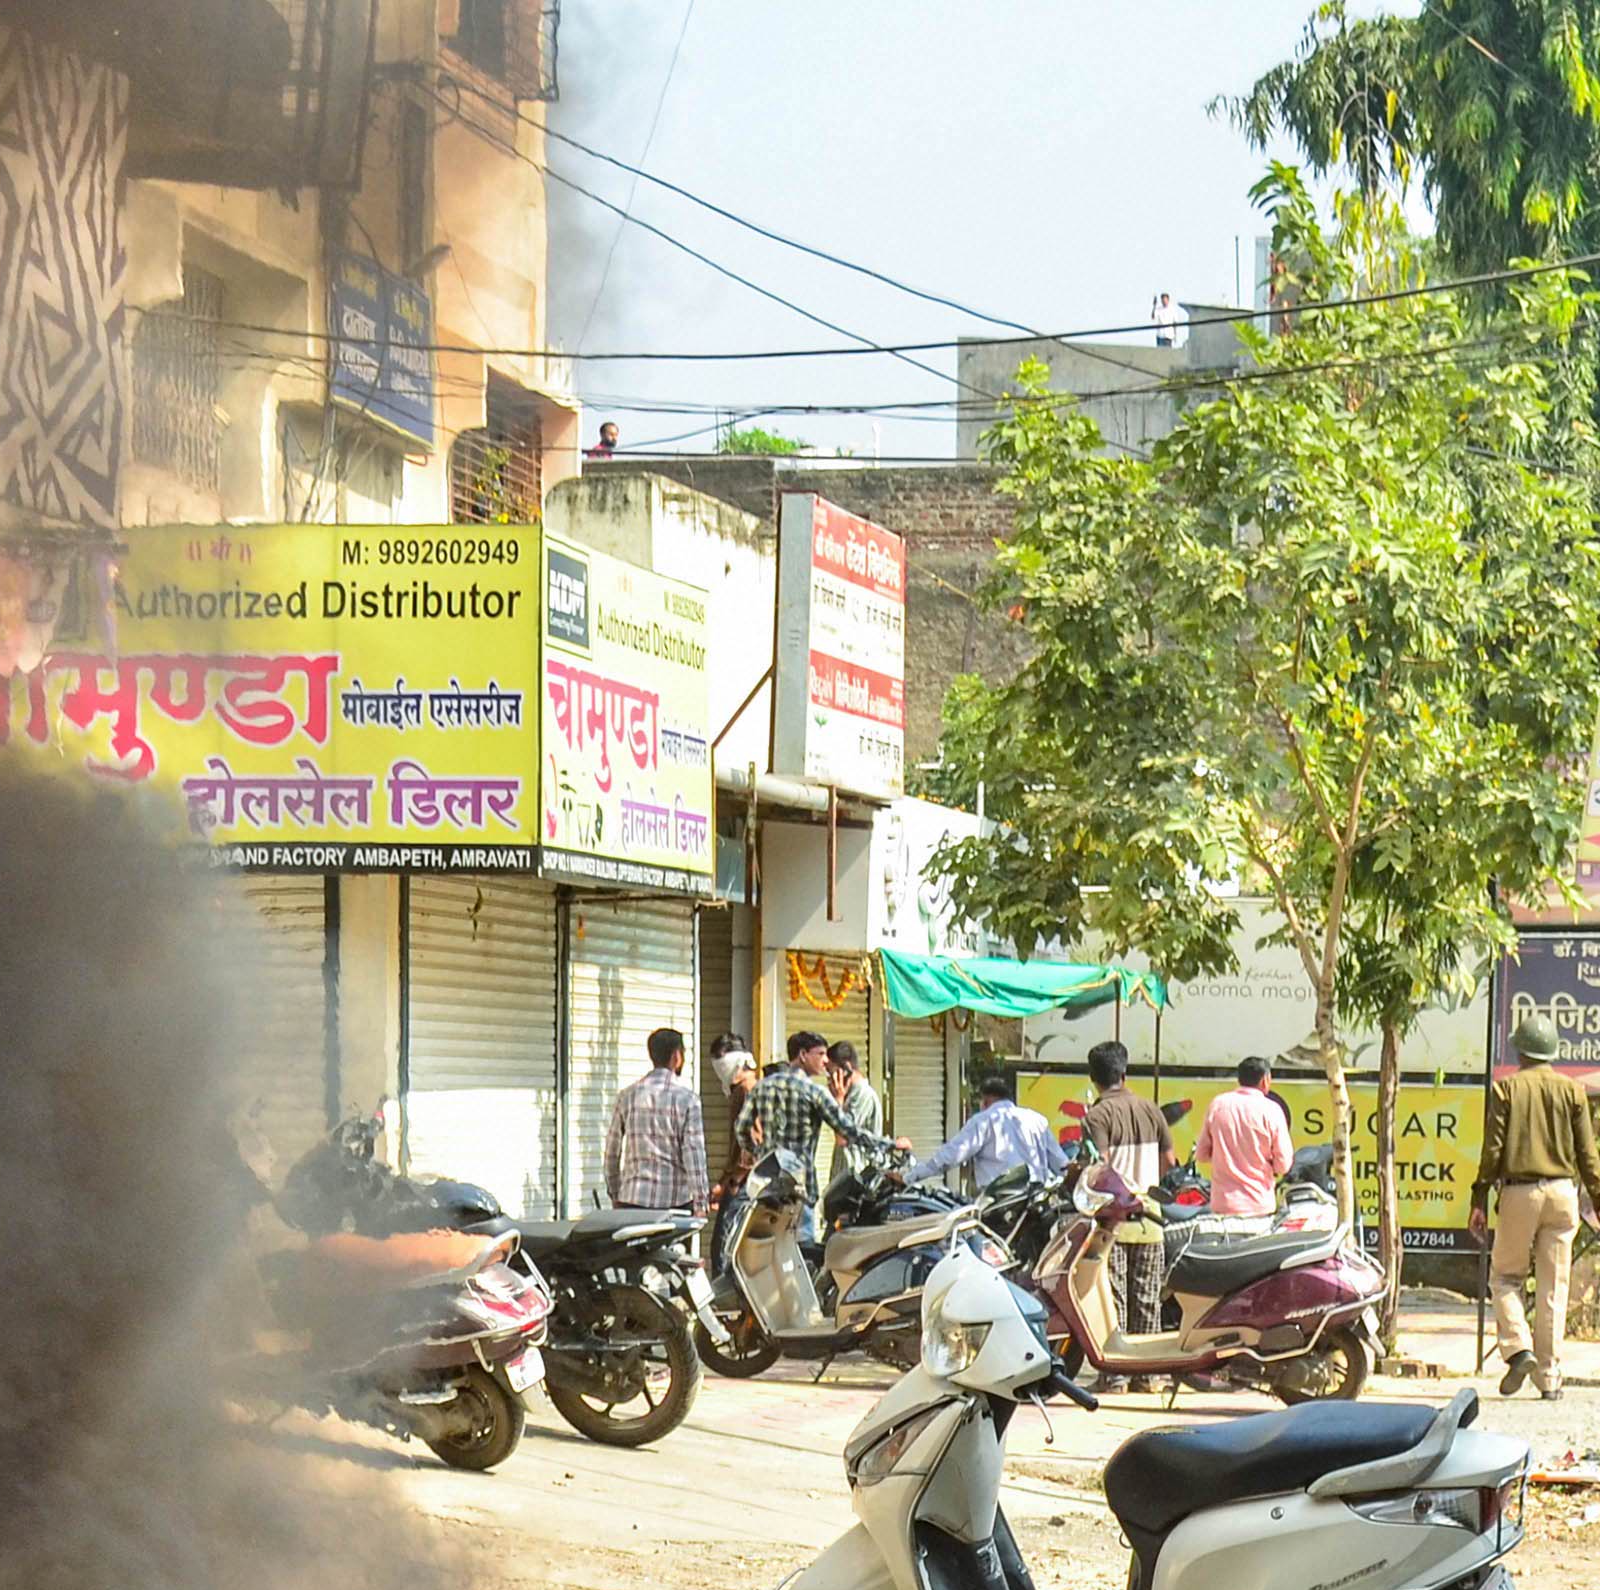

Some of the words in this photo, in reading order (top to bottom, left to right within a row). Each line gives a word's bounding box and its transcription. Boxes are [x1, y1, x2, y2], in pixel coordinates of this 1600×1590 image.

[342, 540, 370, 565] M:
[378, 539, 520, 565] 9892602949
[112, 580, 308, 620] Authorized
[322, 581, 522, 619] Distributor
[548, 568, 586, 620] KDM
[597, 602, 651, 655] Authorized
[653, 621, 706, 672] Distributor
[341, 680, 423, 730] मोबाईल
[546, 659, 660, 793] चामुण्डा
[182, 758, 374, 836] होलसेल
[388, 761, 520, 828] डिलर
[272, 847, 347, 867] FACTORY
[353, 847, 448, 870] AMBAPETH,
[452, 848, 531, 868] AMRAVATI
[1187, 983, 1252, 999] aroma
[1261, 984, 1313, 1002] magi
[1397, 1190, 1455, 1202] LASTING
